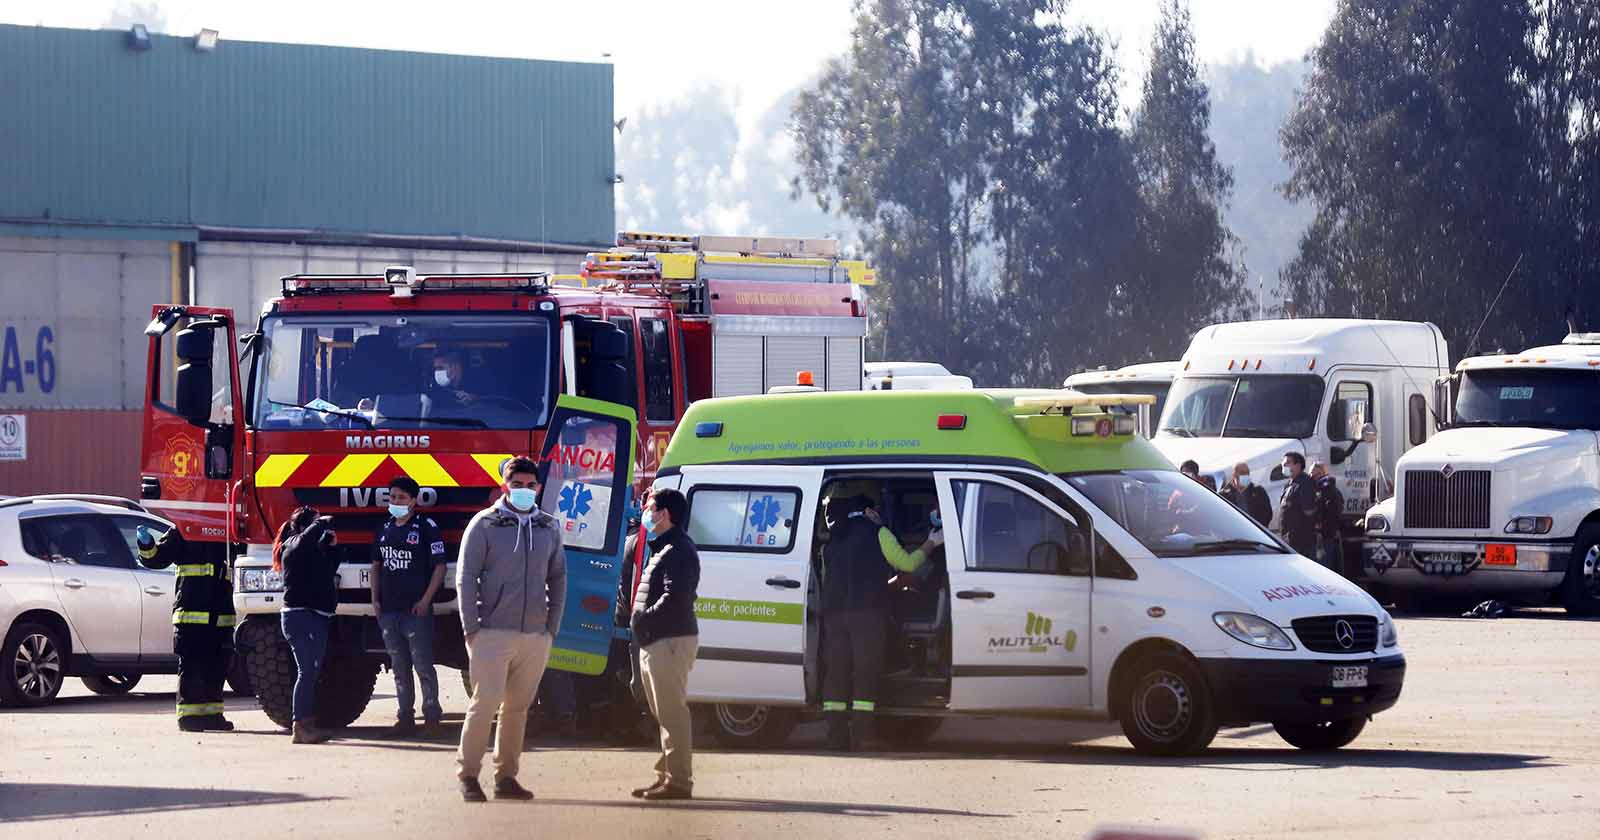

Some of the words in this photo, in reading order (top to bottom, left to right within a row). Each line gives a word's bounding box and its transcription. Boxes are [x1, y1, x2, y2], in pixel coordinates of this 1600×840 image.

[0, 326, 55, 393] A-6
[2, 420, 16, 437] 10
[345, 435, 430, 448] MAGIRUS
[340, 487, 438, 508] IVEO
[390, 559, 411, 571] Sur
[693, 601, 717, 613] scate
[719, 602, 730, 614] de
[733, 604, 777, 617] pacientes
[987, 636, 1065, 648] MUTUAL
